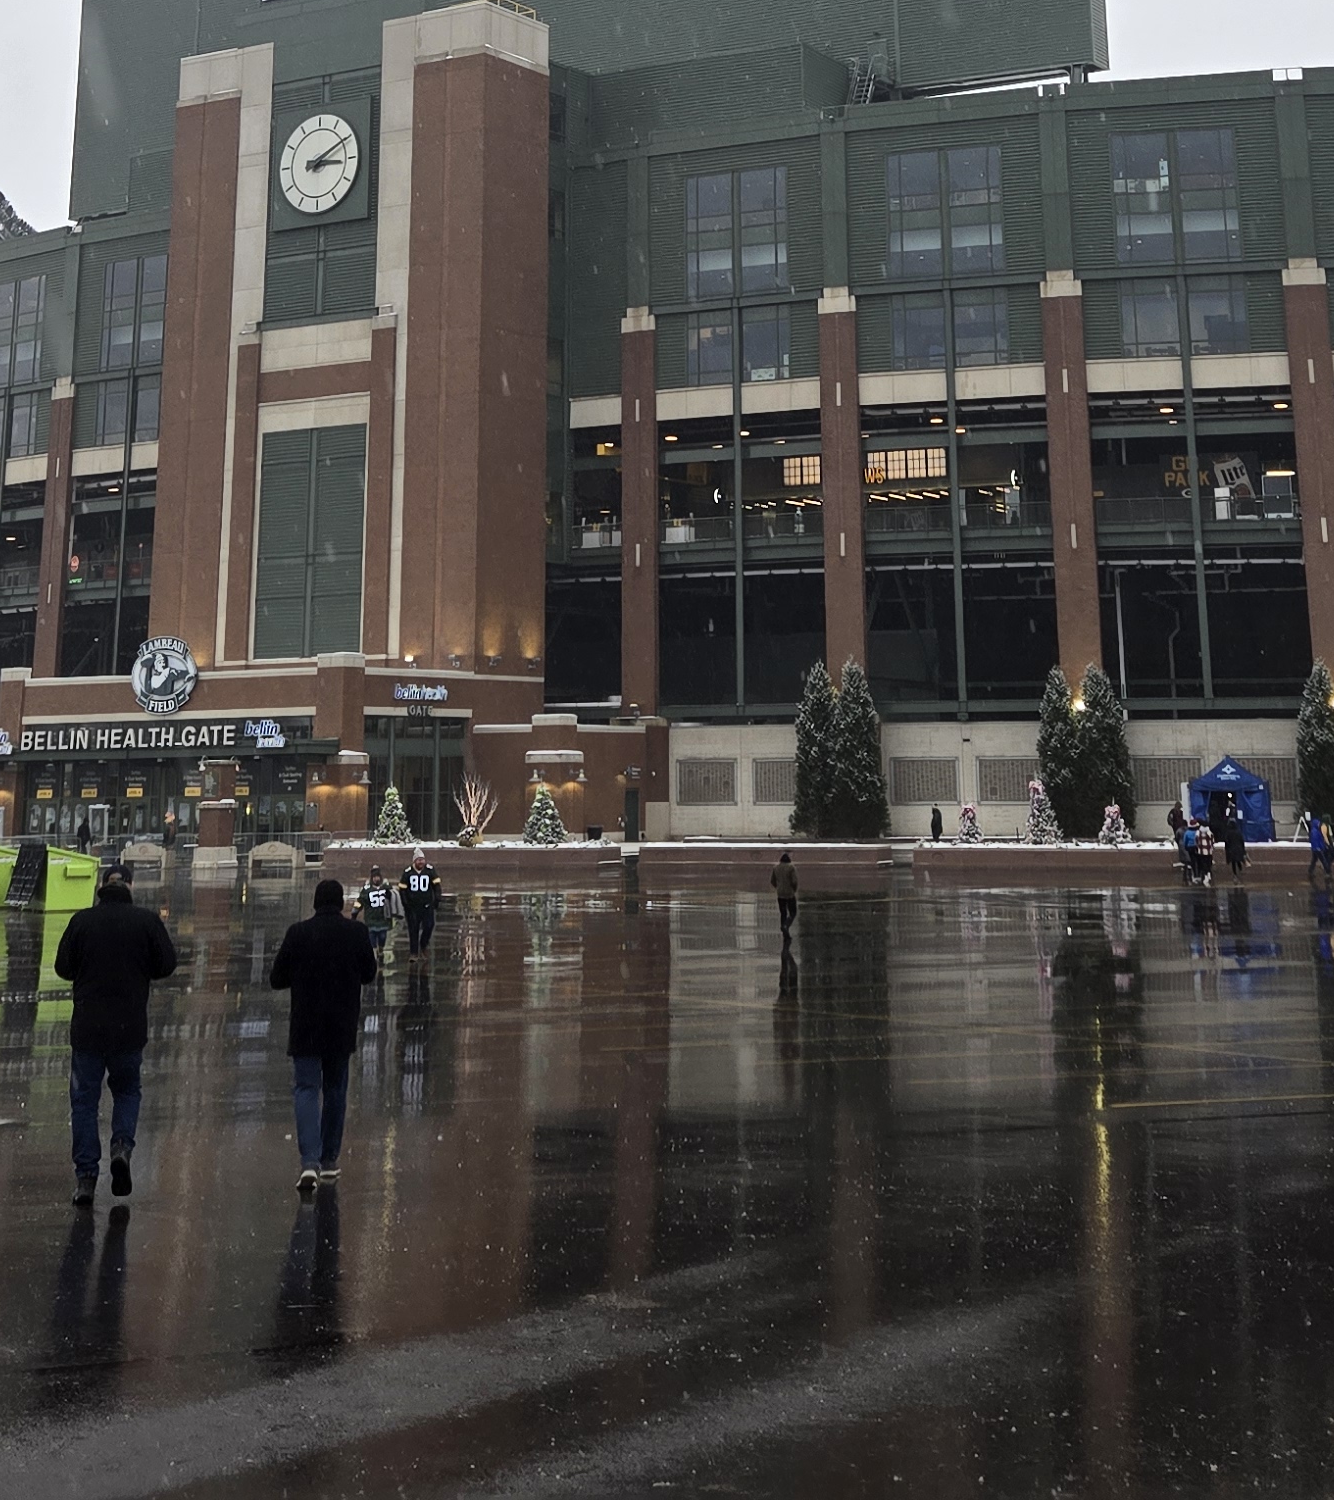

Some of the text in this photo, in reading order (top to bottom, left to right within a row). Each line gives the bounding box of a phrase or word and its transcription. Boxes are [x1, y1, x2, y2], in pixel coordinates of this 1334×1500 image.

[1164, 470, 1210, 487] PAK
[142, 638, 185, 654] LAMBEAU
[148, 700, 175, 712] FIELD
[409, 705, 433, 717] GATE
[244, 719, 280, 737] bellin
[20, 730, 89, 751] BELLIN
[96, 727, 174, 750] HEALTH
[181, 725, 236, 747] GATE
[409, 874, 430, 892] 80
